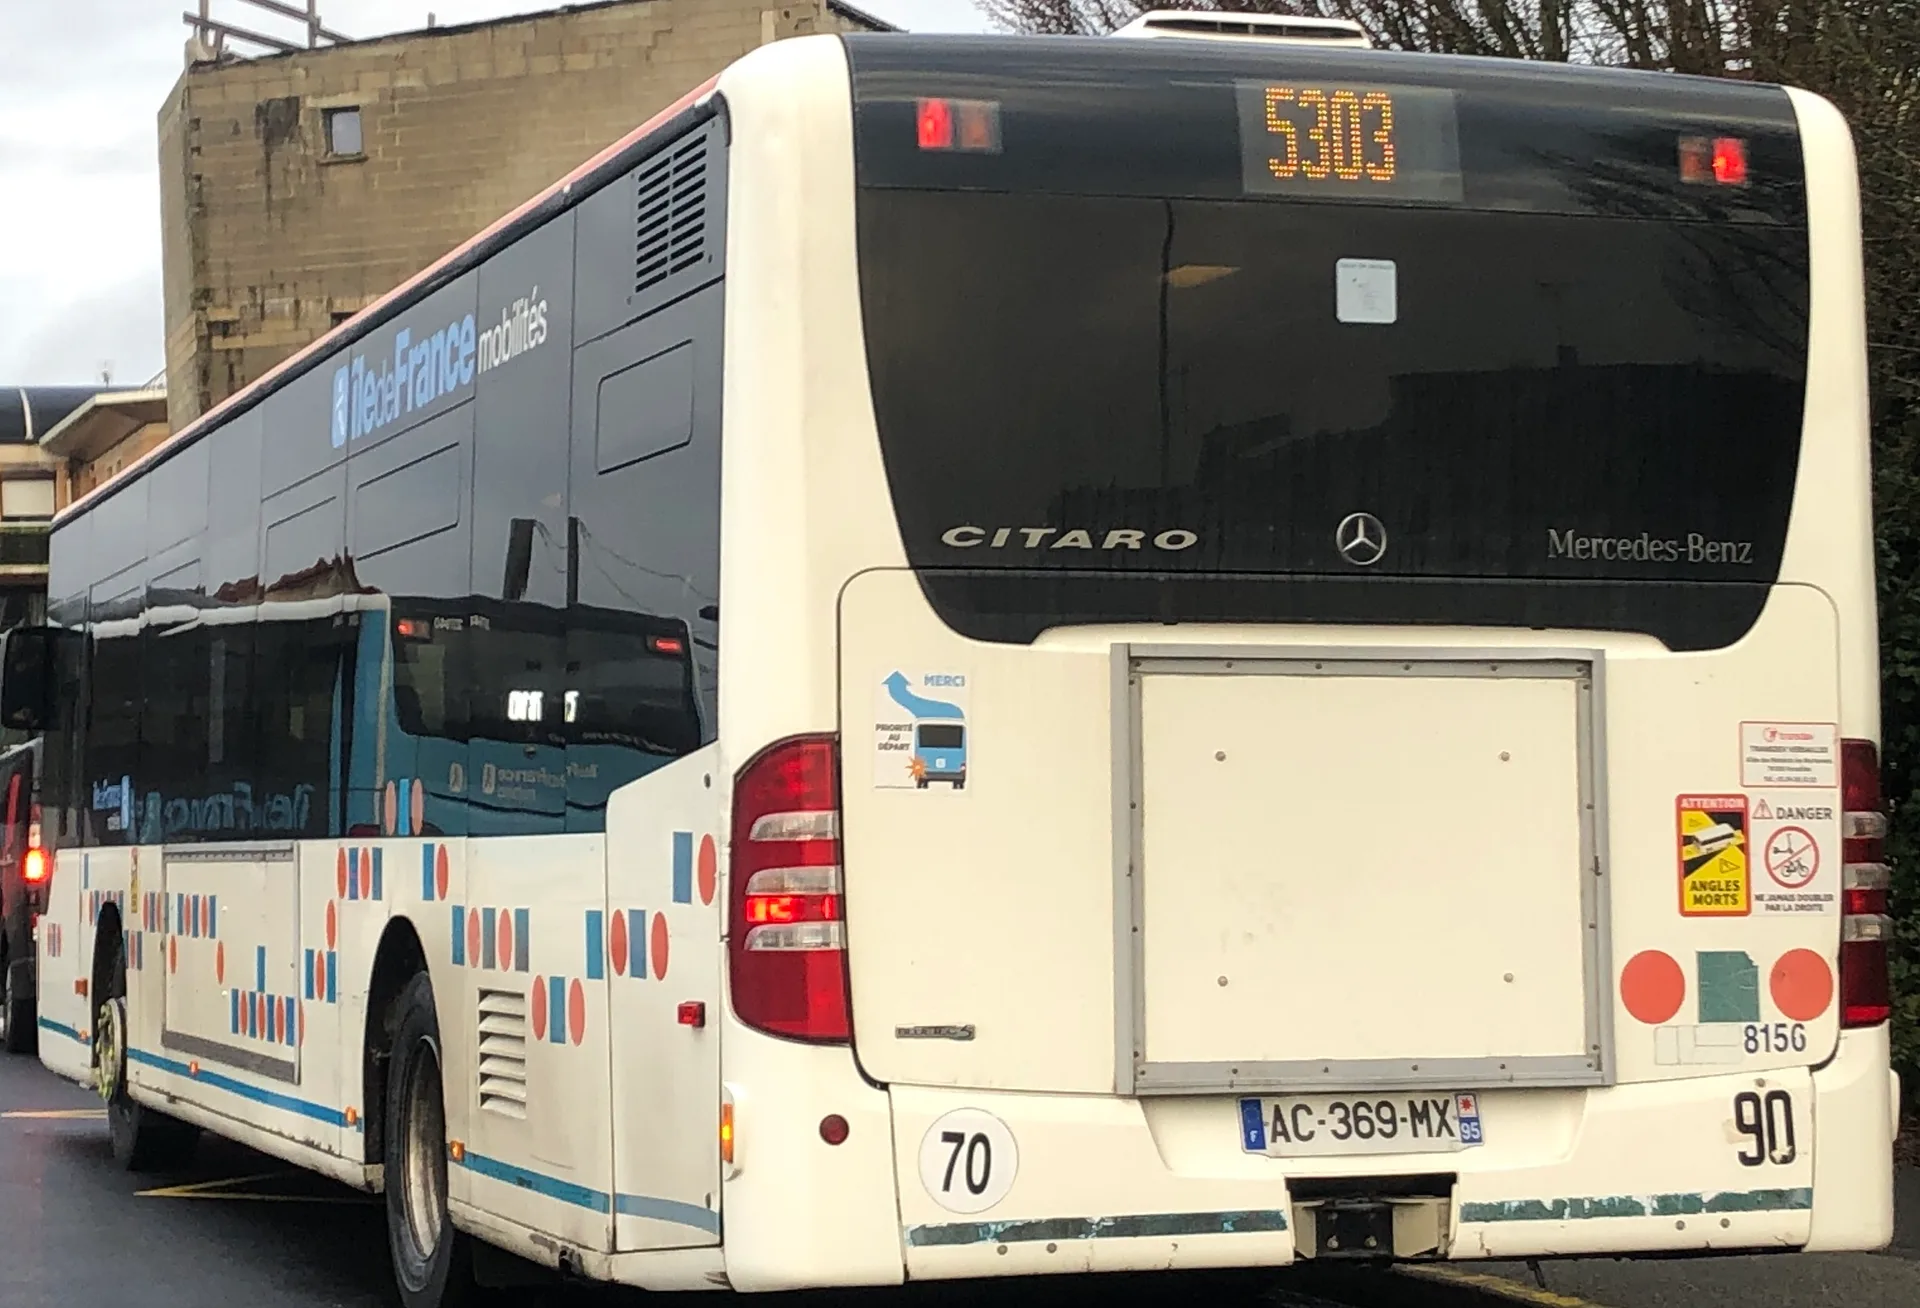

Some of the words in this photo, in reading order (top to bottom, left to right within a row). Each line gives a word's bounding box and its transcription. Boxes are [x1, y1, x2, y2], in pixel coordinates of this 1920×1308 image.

[1265, 87, 1395, 180] 5303
[477, 285, 548, 375] mobilités
[941, 526, 1198, 550] CITARO
[1547, 528, 1753, 564] Mercedes-Benz
[924, 675, 965, 687] MERCI
[875, 723, 913, 732] PRIORITÉ
[888, 733, 901, 742] AU
[877, 742, 911, 751] DÉPART
[1681, 798, 1746, 809] ATTENTION
[1775, 807, 1833, 820] DANGER
[1690, 880, 1740, 892] ANGLES
[1692, 894, 1739, 906] MORTS
[1754, 894, 1765, 902] NE
[1765, 904, 1781, 912] PAR
[1783, 904, 1793, 912] LA
[1743, 1023, 1807, 1054] 8156
[1270, 1098, 1456, 1144] AC-369-MX
[1459, 1121, 1481, 1141] 95
[1733, 1090, 1796, 1167] 90
[941, 1131, 992, 1195] 70
